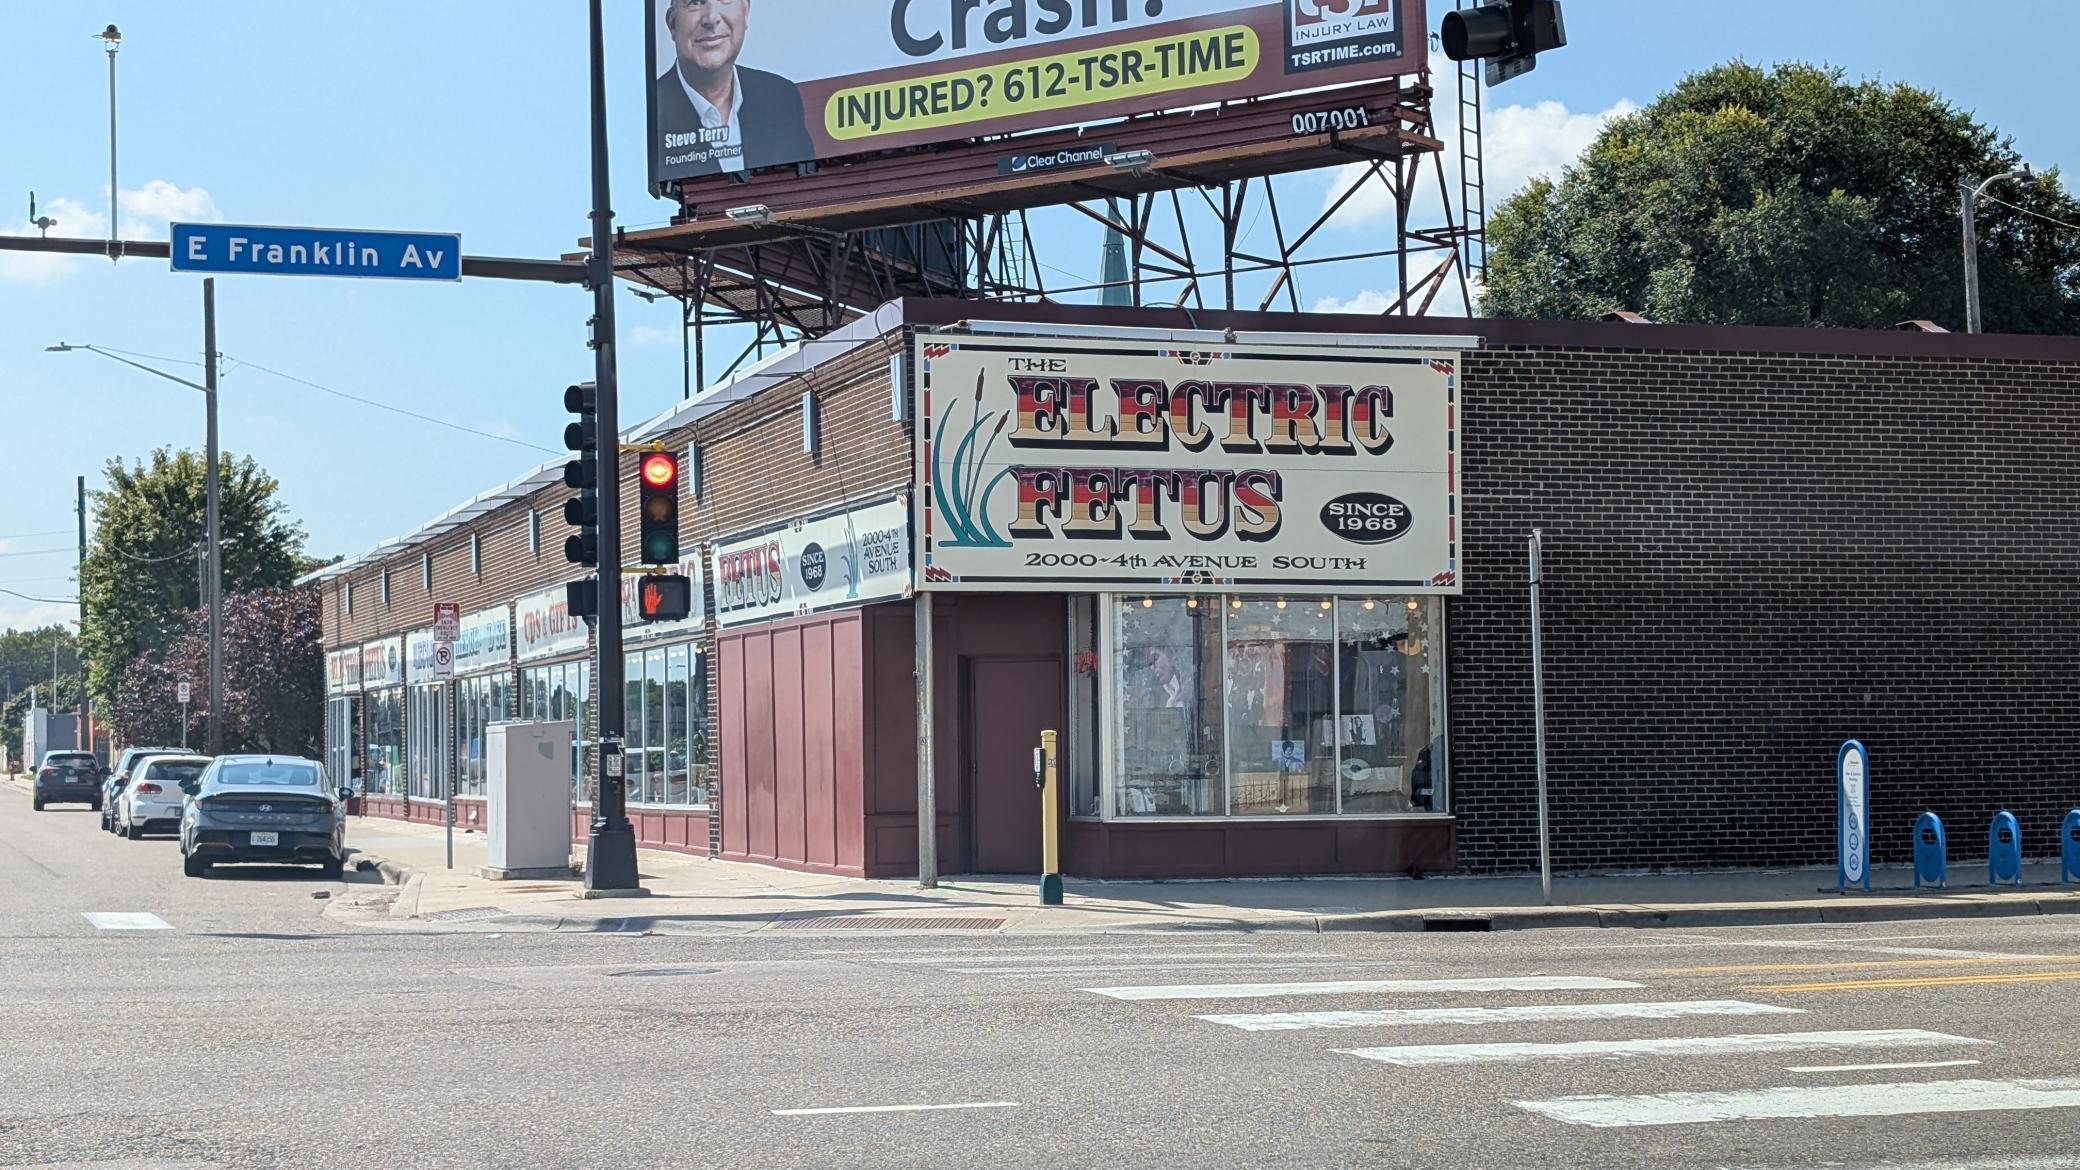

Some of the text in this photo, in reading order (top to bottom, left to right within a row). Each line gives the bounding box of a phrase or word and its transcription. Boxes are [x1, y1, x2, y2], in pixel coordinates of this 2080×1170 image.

[1296, 17, 1389, 40] INJURY LAW
[1291, 42, 1396, 67] TSRTIME.com
[838, 32, 1245, 131] INJURED? 612-TSR-TIME
[1292, 106, 1368, 134] 007001
[665, 126, 729, 148] Steve Terry
[666, 146, 742, 165] Founding Partner
[1027, 147, 1103, 168] Clear Channel
[188, 236, 444, 269] E Franklin Av
[1008, 358, 1067, 372] THE
[1007, 375, 1394, 457] ELECTRIC
[1008, 467, 1283, 543] FETUS
[1329, 502, 1404, 517] SINCE
[1338, 517, 1398, 531] 1968
[803, 551, 824, 566] SINCE
[863, 542, 899, 560] AVENUE
[805, 565, 823, 579] 1968
[868, 556, 897, 574] SOUTH
[1152, 555, 1258, 569] AVENUE
[1272, 555, 1368, 570] SOUTH
